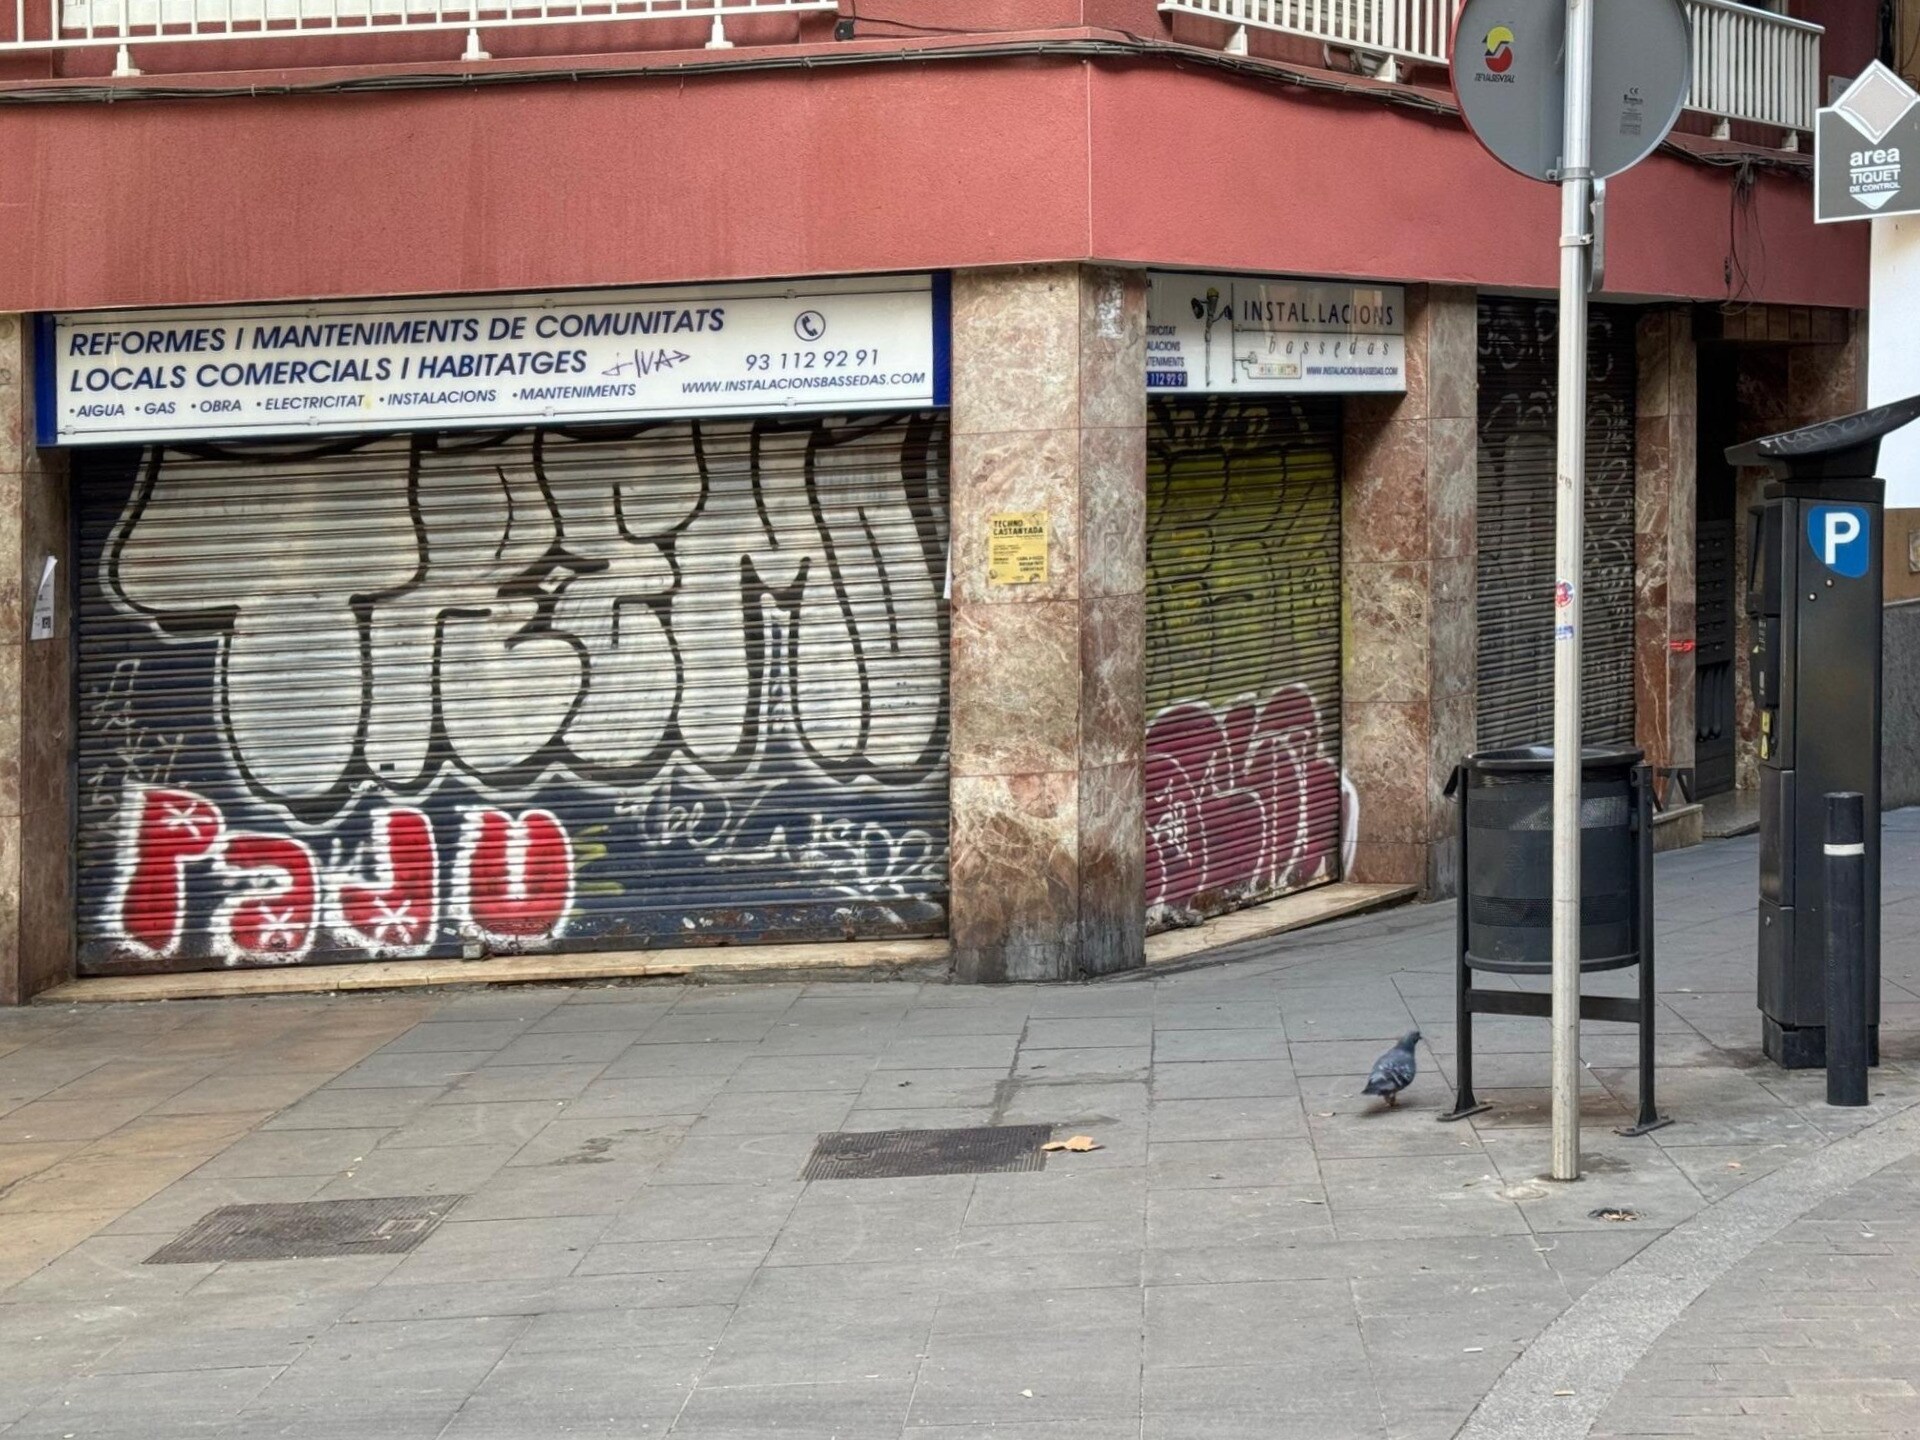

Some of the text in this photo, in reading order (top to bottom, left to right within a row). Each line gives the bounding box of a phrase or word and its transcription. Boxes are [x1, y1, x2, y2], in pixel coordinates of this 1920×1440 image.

[1850, 148, 1900, 166] area
[1849, 183, 1901, 193] DE CONTROL
[1850, 170, 1901, 184] TIQUET
[1243, 300, 1394, 326] INSTAL.LACIONS
[69, 327, 225, 357] REFORMES
[252, 317, 479, 350] MANTENIMENTS
[488, 316, 528, 341] DE
[536, 307, 726, 339] COMUNITATS
[1146, 341, 1181, 351] ALACIONS
[1268, 335, 1390, 358] bassedas
[69, 365, 187, 392] LOCALS
[196, 357, 393, 388] COMERCIALS
[417, 349, 588, 379] HABITATGES
[745, 348, 880, 371] 93 112 92 91
[681, 372, 926, 395] WWW.INSTALACIONSBASSEDAS.COM
[1150, 373, 1165, 385] 112
[1166, 373, 1176, 386] 92
[76, 383, 637, 418] AIGUA GAS OBRA ELECTRICITAT INSTALACIONS MANTENIMENTS
[993, 527, 1043, 535] CASTANYADA
[1824, 511, 1861, 565] P
